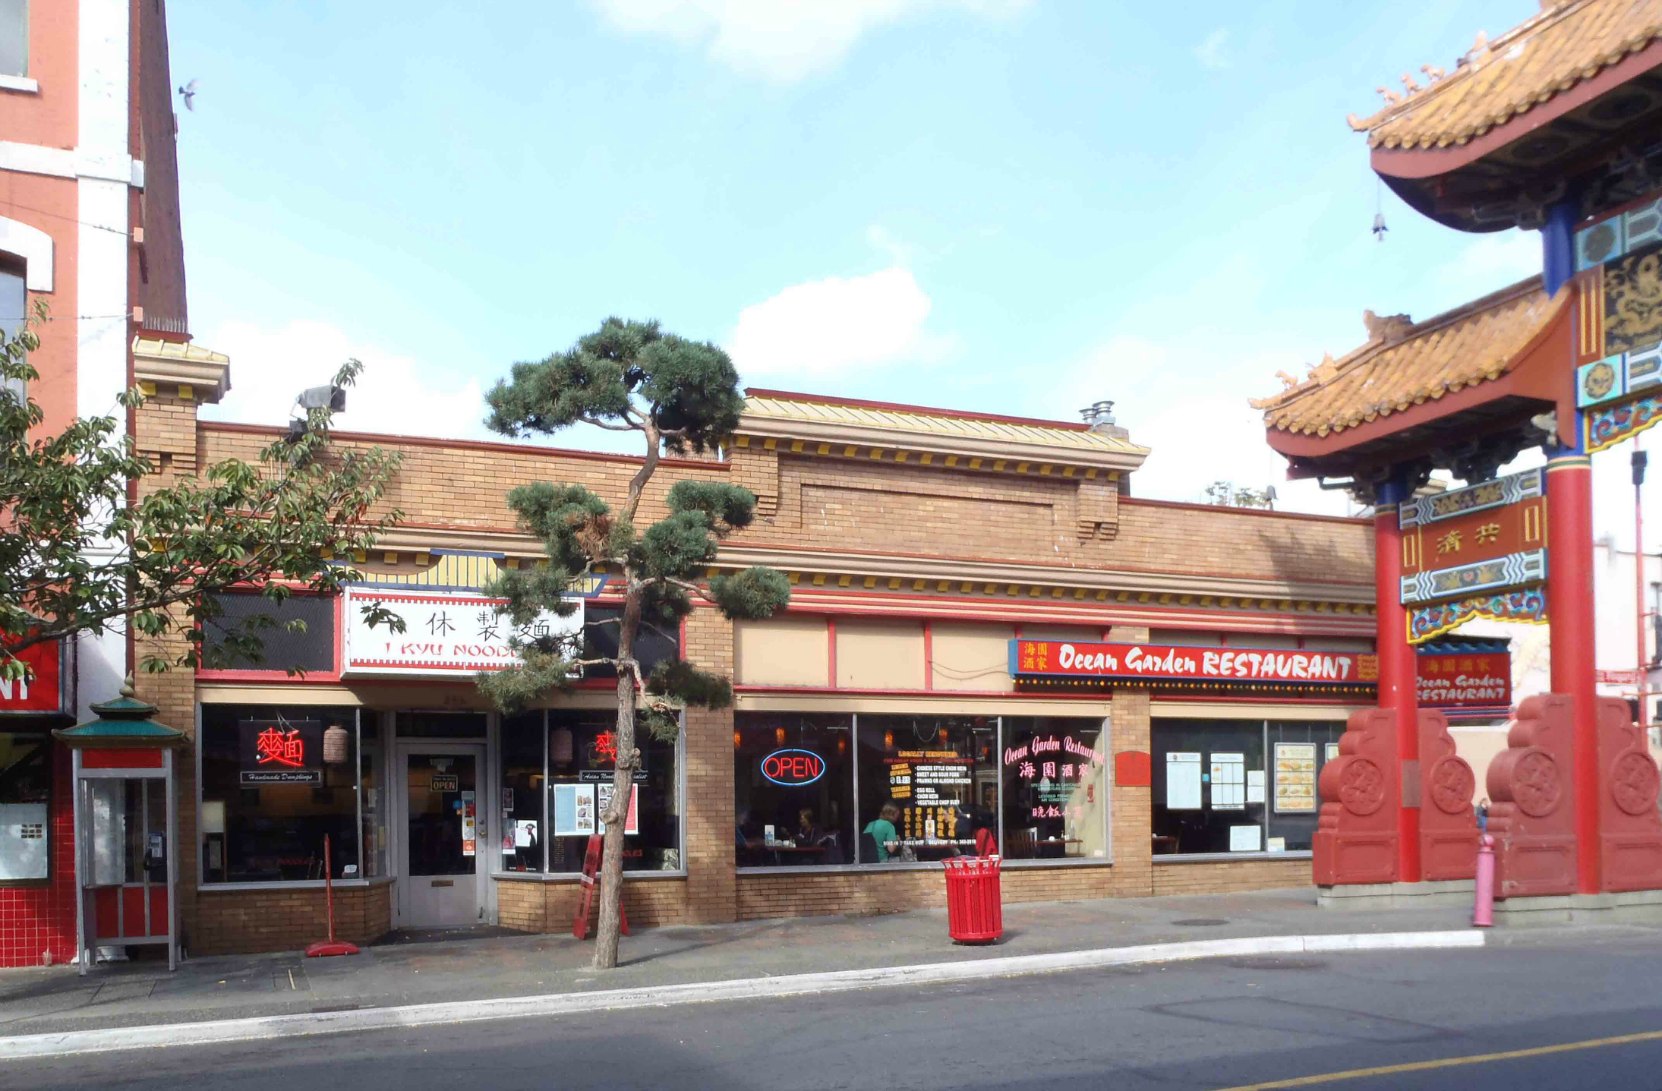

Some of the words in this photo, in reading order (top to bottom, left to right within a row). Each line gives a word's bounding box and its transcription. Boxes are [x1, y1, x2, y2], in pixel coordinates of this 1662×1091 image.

[401, 643, 443, 656] KYU
[1059, 643, 1118, 671] Ocean
[1124, 646, 1196, 673] Garden
[1202, 651, 1352, 680] RESTAURANT
[1455, 674, 1505, 688] Garden
[1004, 746, 1028, 766] Ocean
[1031, 735, 1060, 756] Garden
[1063, 735, 1105, 764] Restaurant
[764, 757, 819, 778] OPEN
[433, 781, 456, 790] OPEN
